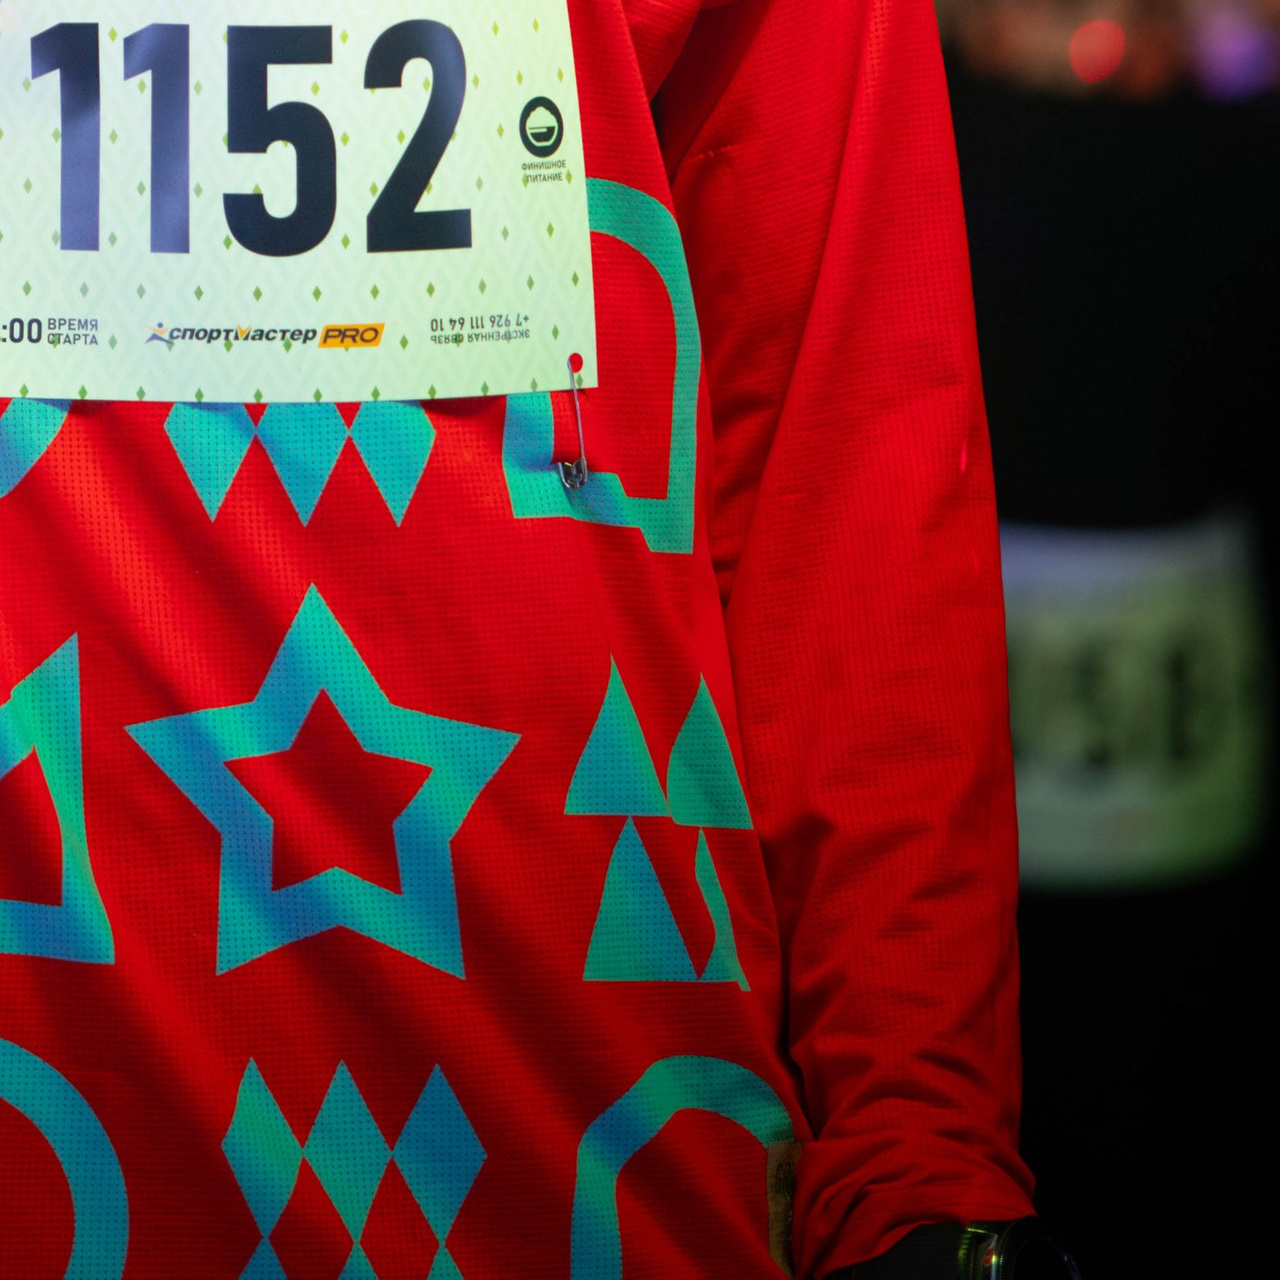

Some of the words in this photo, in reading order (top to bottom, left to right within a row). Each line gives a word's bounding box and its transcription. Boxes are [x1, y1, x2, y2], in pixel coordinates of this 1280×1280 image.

[30, 18, 473, 258] 1152
[521, 160, 567, 171] ФИНИШНОЕ
[526, 172, 563, 183] ПИТАНИЕ
[47, 318, 99, 331] ВРЕМЯ
[430, 318, 444, 332] 10
[449, 317, 465, 331] 64
[470, 316, 485, 329] 111
[489, 314, 511, 329] 926
[515, 313, 530, 327] +7
[47, 333, 99, 346] СТАРТА
[322, 326, 379, 344] PRO
[430, 333, 464, 344] СВЯЗЬ
[467, 329, 530, 343] ЭКСТРЕННАЯ
